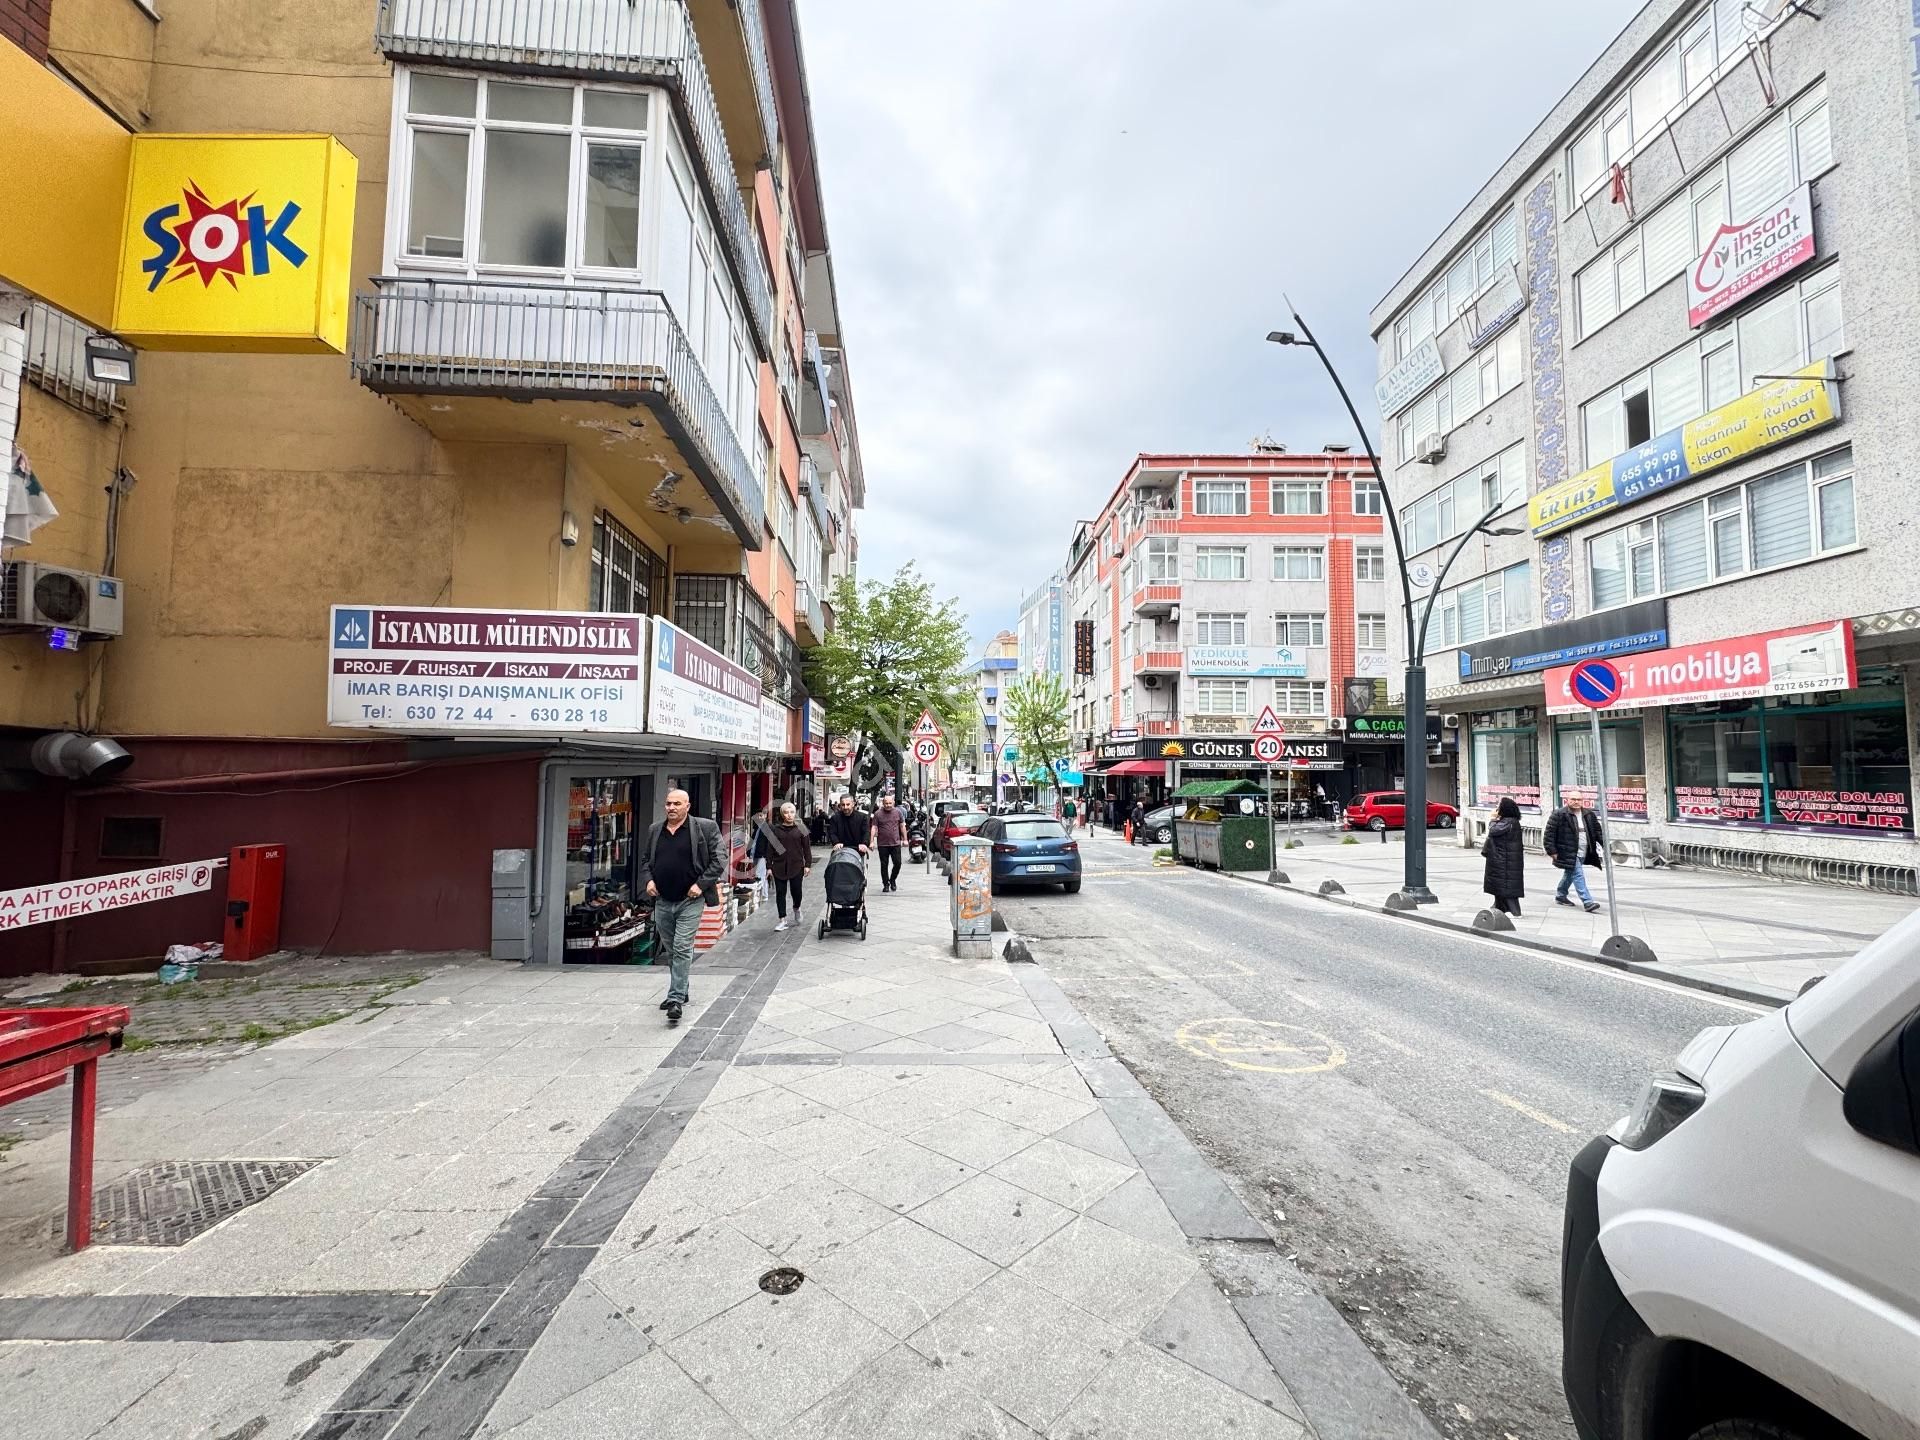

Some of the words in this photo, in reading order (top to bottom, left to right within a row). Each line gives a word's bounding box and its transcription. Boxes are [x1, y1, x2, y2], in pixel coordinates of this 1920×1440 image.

[1734, 207, 1790, 254] ihsan
[143, 199, 309, 293] ŞOK
[1730, 278, 1749, 293] 515
[1750, 267, 1765, 280] 04
[1766, 257, 1780, 272] 46
[1781, 243, 1804, 264] pbx
[1621, 465, 1642, 482] 655
[1643, 457, 1659, 475] 99
[1662, 449, 1678, 468] 98
[1623, 480, 1646, 498] 651
[1648, 472, 1664, 488] 34
[1666, 465, 1681, 482] 77
[378, 614, 480, 645] İSTANBUL
[484, 618, 632, 649] MÜHENDİSLİK
[1193, 647, 1249, 658] YEDİKULE
[343, 661, 393, 674] PROJE
[417, 663, 477, 677] RUHSAT
[504, 662, 549, 677] İSKAN
[578, 663, 630, 680] İNŞAAT
[684, 642, 720, 689] İSTANBUL
[1191, 659, 1249, 667] MÜHENDİSLİK
[1646, 650, 1761, 684] mobilya
[347, 680, 391, 697] İMAR
[396, 683, 453, 701] BARIŞI
[459, 685, 576, 702] DANIŞMANLIK
[580, 685, 623, 701] OFİSİ
[1774, 681, 1796, 692] 0212
[1797, 678, 1817, 690] 656
[1818, 677, 1830, 688] 27
[1831, 676, 1844, 687] 77
[362, 704, 393, 719] Tel:
[406, 705, 436, 720] 630
[445, 706, 464, 721] 72
[473, 706, 494, 721] 44
[530, 707, 560, 722] 630
[564, 708, 584, 723] 28
[589, 709, 608, 723] 18
[920, 744, 935, 756] 20
[1192, 741, 1243, 757] GÜNEŞ
[1260, 741, 1277, 754] 20
[1775, 790, 1837, 801] MUTFAK
[1840, 791, 1904, 804] DOLABI
[1780, 810, 1904, 828] YAPILIR
[1868, 805, 1909, 813] YAPILIR
[0, 894, 16, 911] A
[21, 888, 53, 907] AİT
[58, 875, 142, 901] OTOPARK
[146, 866, 188, 886] GİRİŞİ
[28, 901, 92, 924] ETMEK
[98, 885, 175, 910] YASAKTIR
